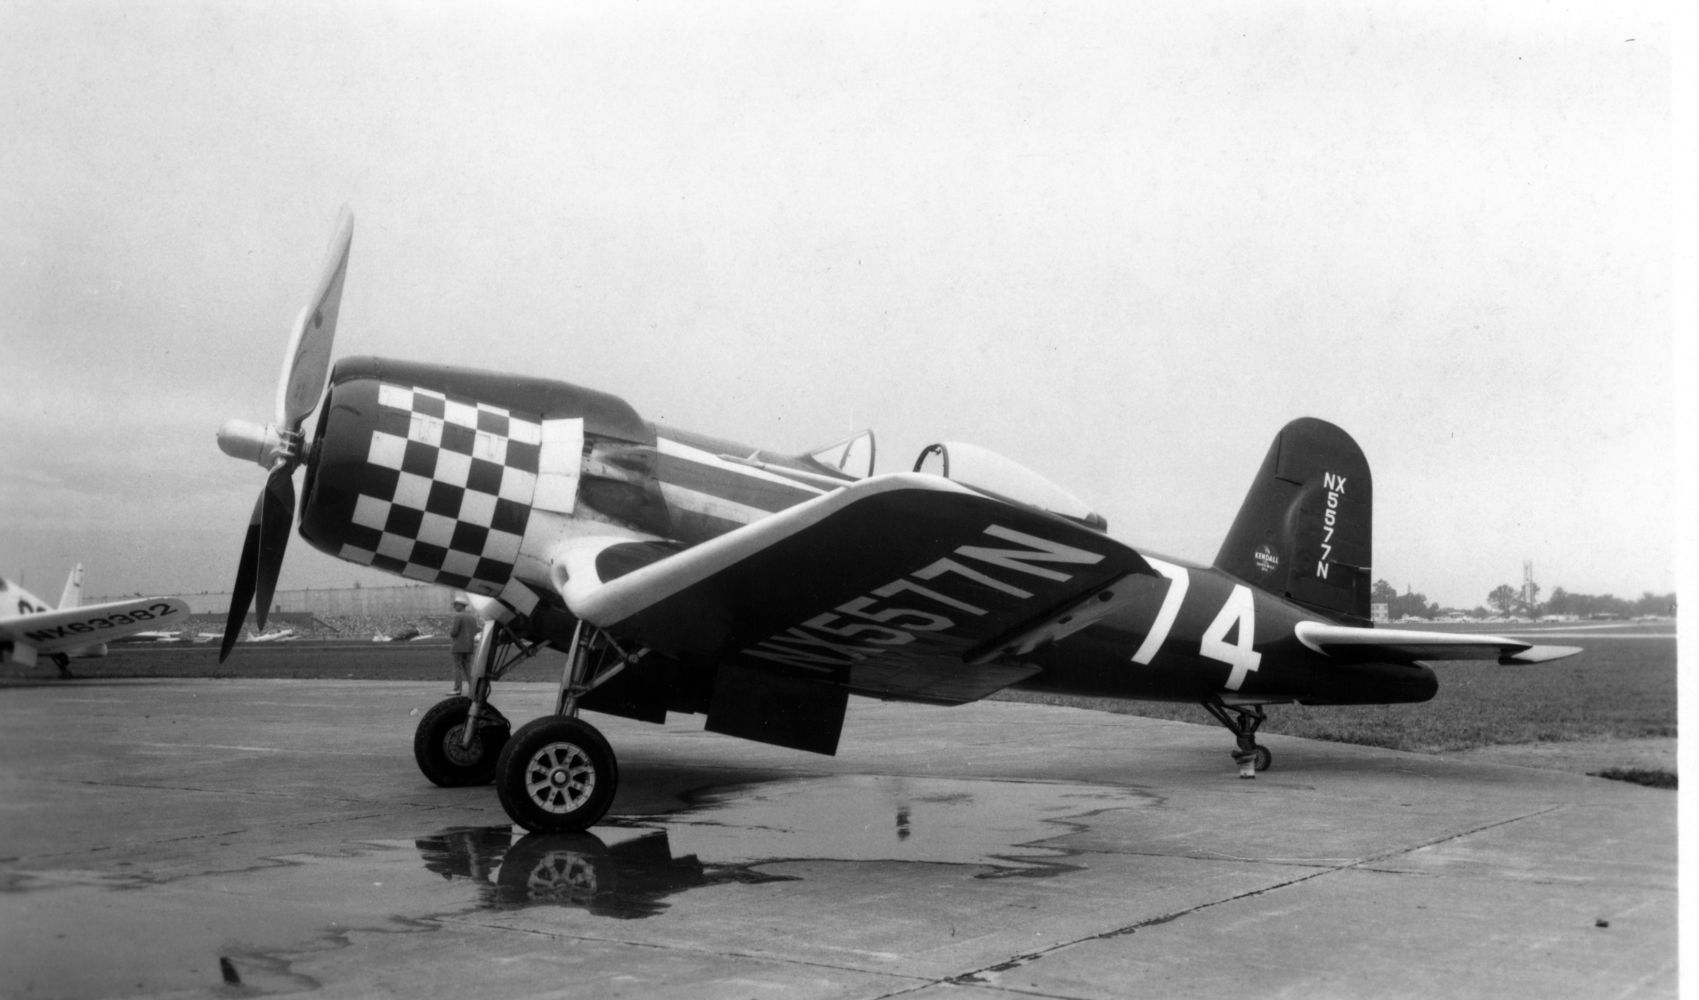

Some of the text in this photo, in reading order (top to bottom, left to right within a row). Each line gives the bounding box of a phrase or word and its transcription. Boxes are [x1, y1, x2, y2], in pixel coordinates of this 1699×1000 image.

[741, 523, 1106, 673] NX5577N
[1131, 554, 1262, 691] 74
[1254, 551, 1279, 565] KENDALL
